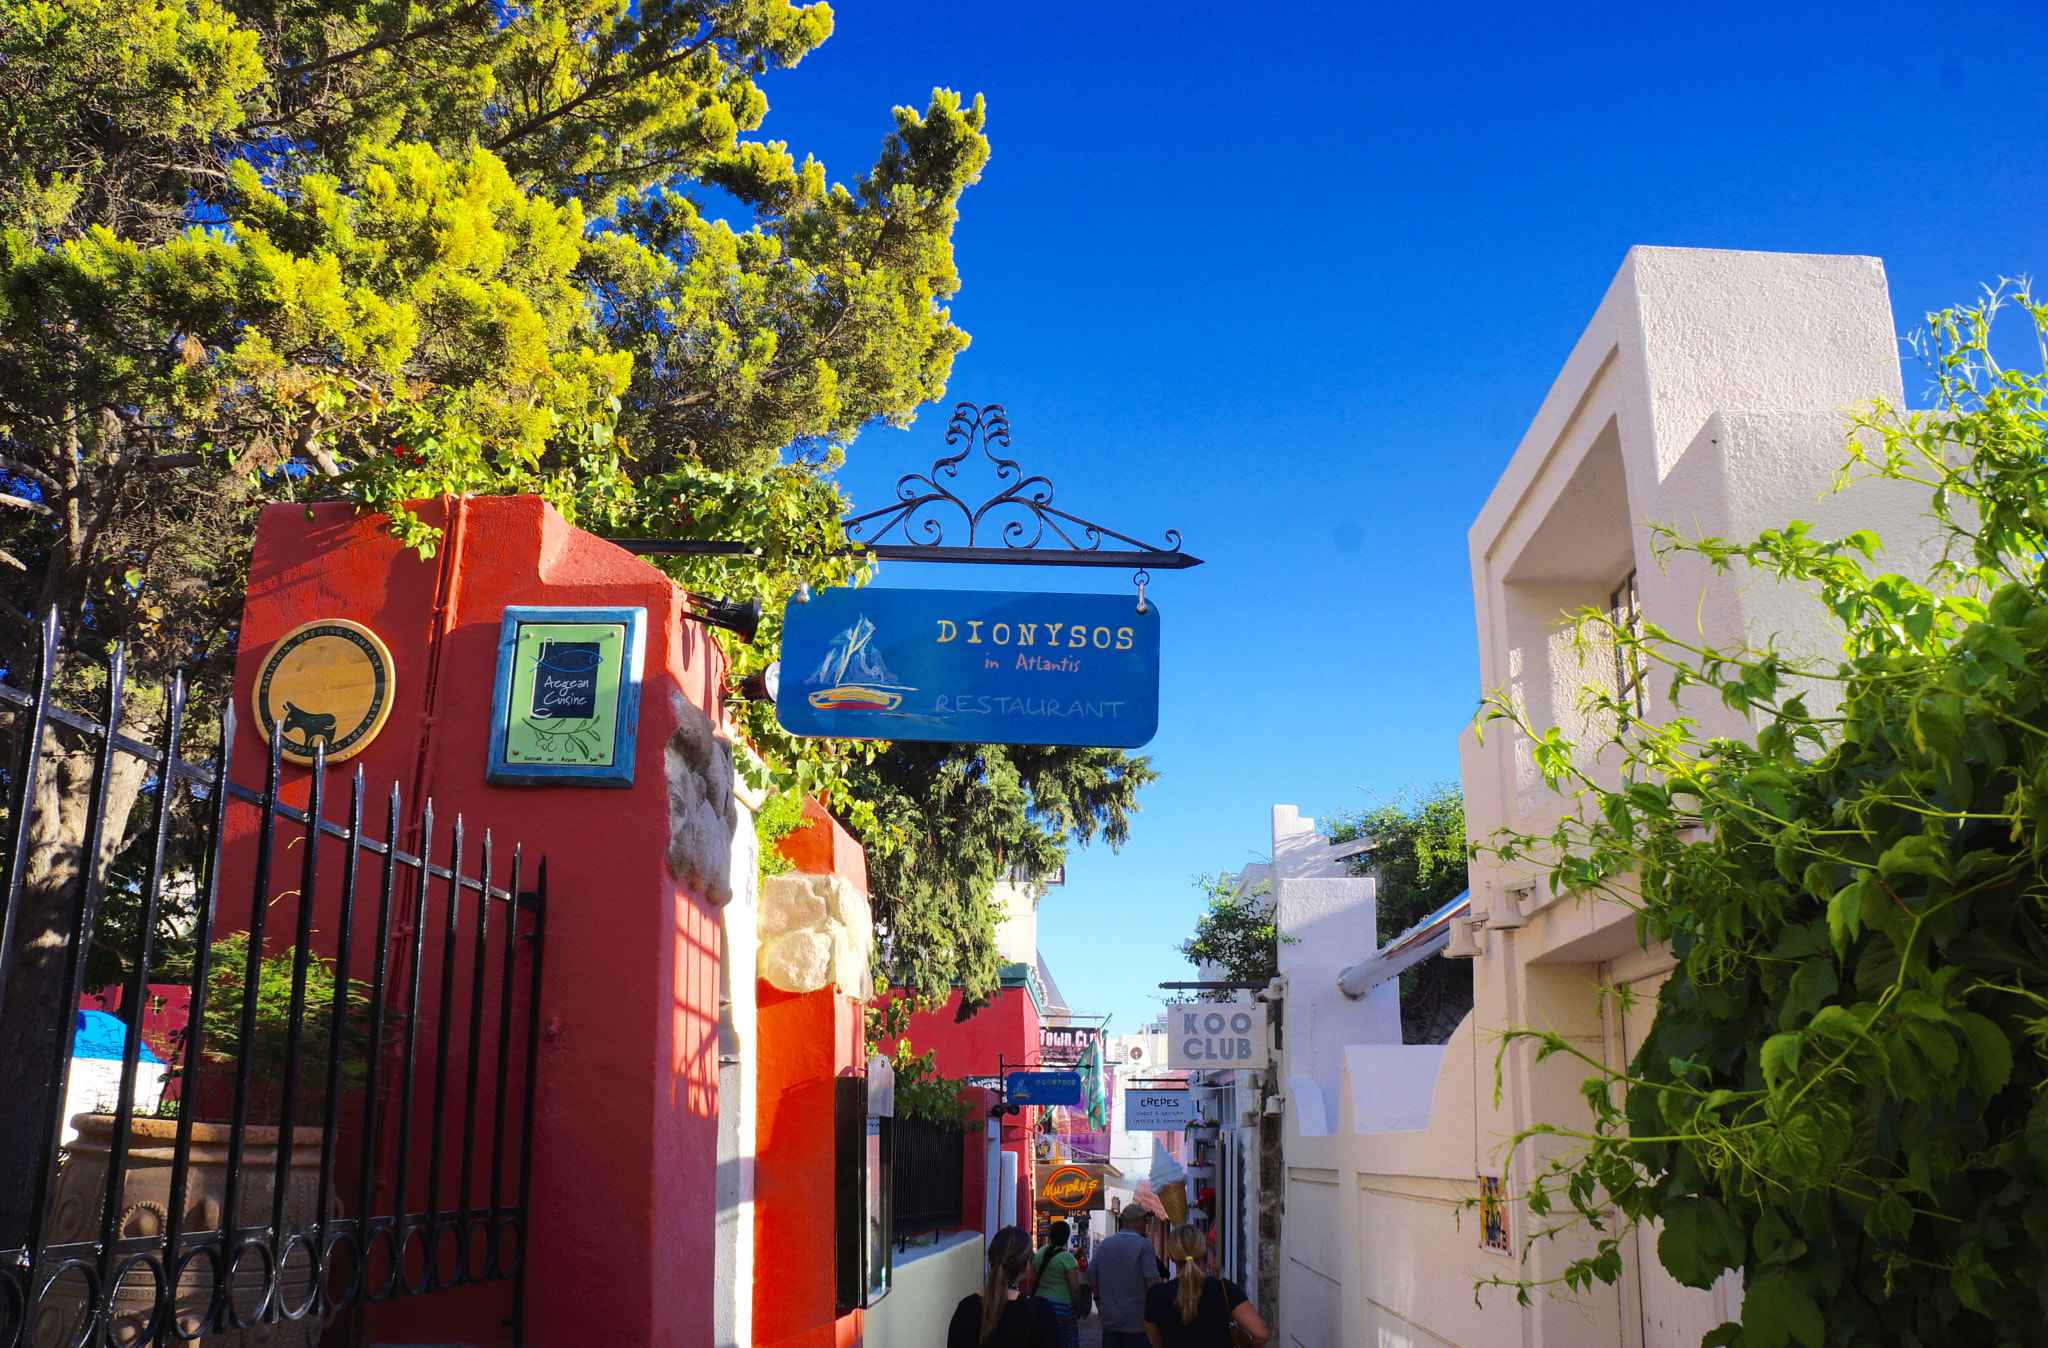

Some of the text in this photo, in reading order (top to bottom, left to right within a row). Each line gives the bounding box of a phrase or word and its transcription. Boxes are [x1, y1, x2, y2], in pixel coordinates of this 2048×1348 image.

[297, 628, 342, 643] BREWING
[936, 620, 1135, 650] DIONYSOS
[984, 652, 1081, 672] in Atlantis
[543, 675, 589, 696] Aegean
[543, 691, 588, 706] Cuisine
[935, 694, 1125, 719] RESTAURANT
[1183, 1012, 1252, 1035] KOO
[1182, 1037, 1252, 1060] CLUB
[1140, 1097, 1179, 1107] CREPES
[1042, 1178, 1099, 1198] Murphy's
